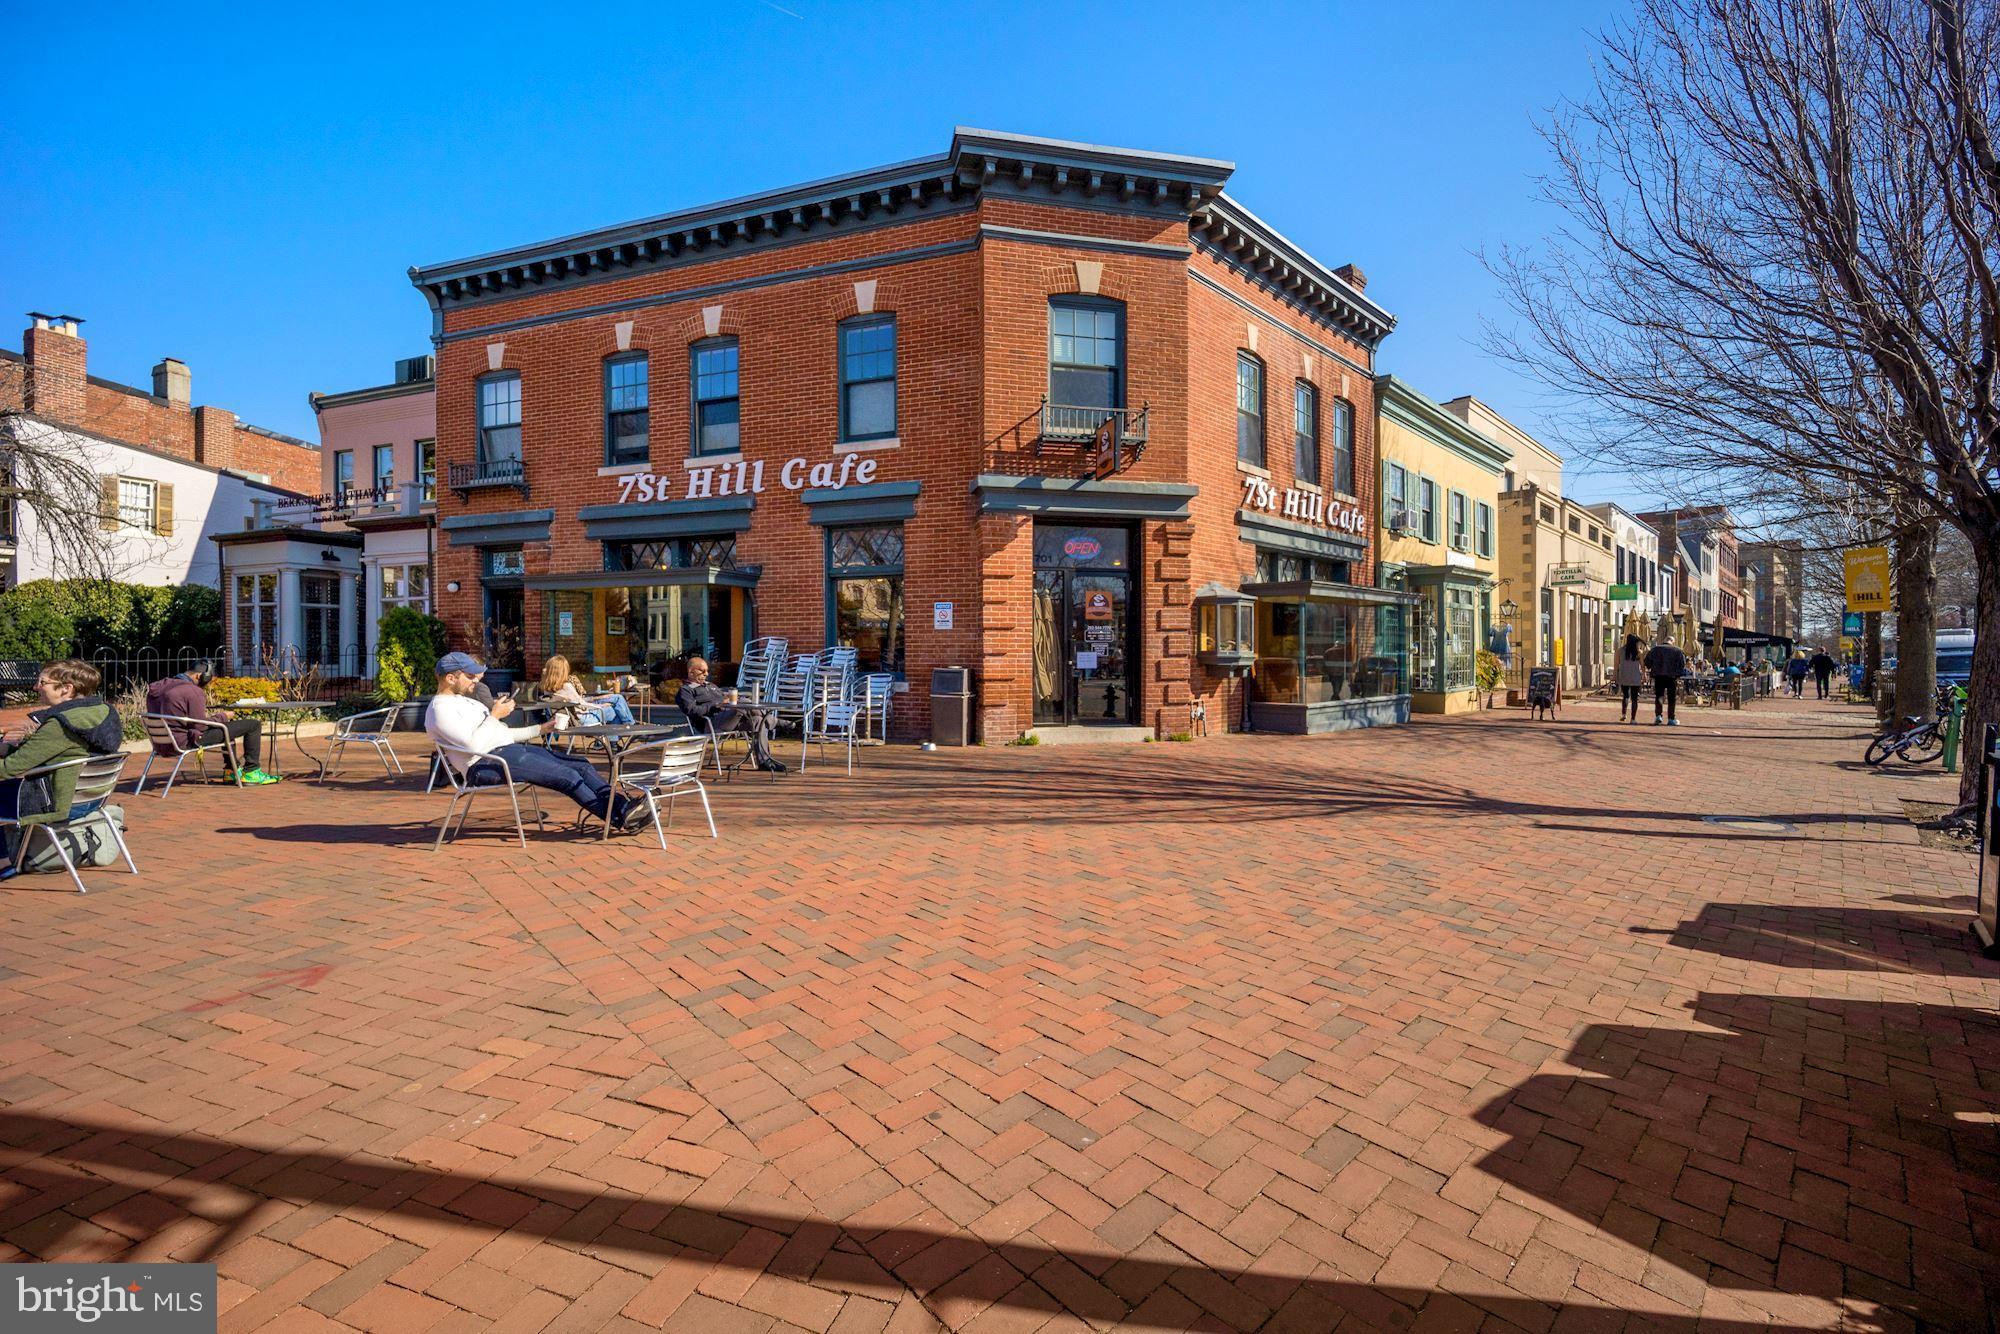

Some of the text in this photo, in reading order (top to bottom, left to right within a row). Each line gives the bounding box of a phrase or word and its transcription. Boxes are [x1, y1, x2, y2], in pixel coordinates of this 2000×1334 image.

[685, 460, 766, 500] Hill
[780, 453, 878, 490] Cafe
[278, 493, 331, 508] BERKSHIRE
[1284, 487, 1323, 523] Hill
[1327, 500, 1365, 533] Cafe
[1064, 541, 1100, 555] OPEN
[1034, 554, 1052, 563] 701
[1857, 592, 1883, 601] HILL
